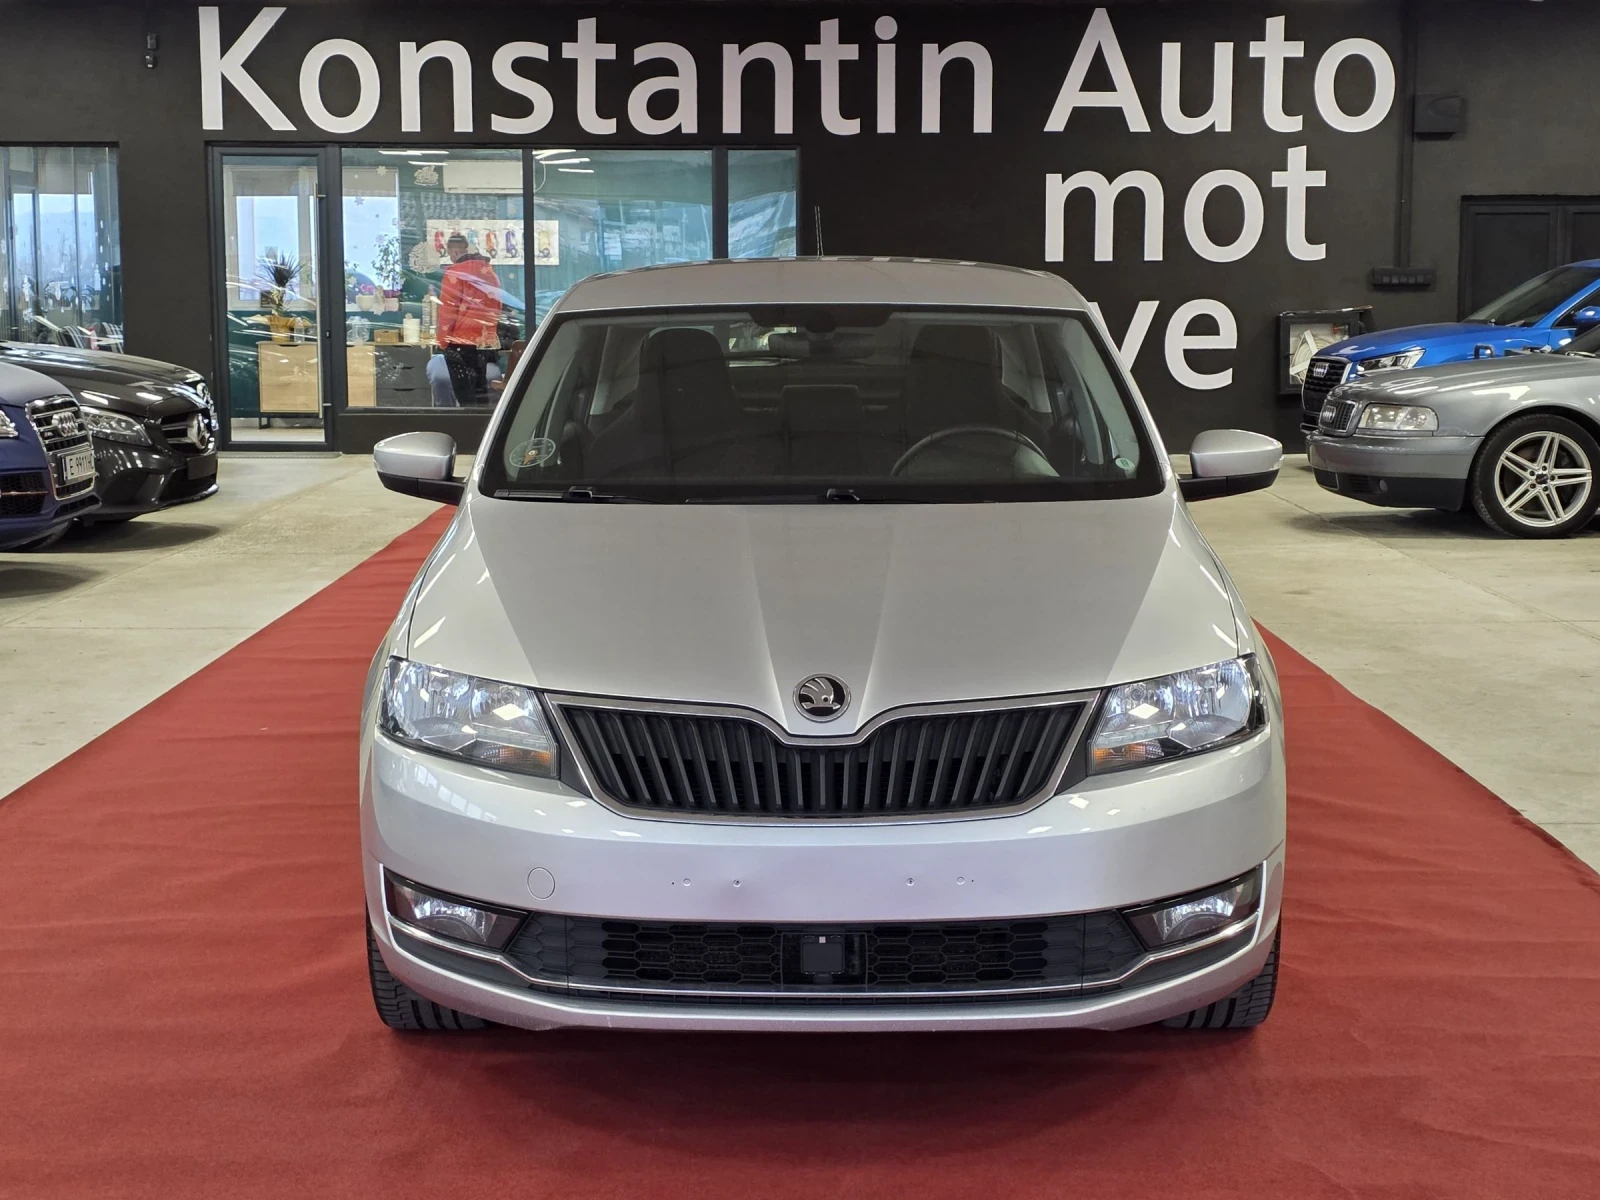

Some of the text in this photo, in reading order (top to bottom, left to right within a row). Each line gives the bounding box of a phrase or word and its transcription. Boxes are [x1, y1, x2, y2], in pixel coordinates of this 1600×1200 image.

[198, 6, 1396, 136] Konstantin Auto
[1044, 145, 1327, 262] mot
